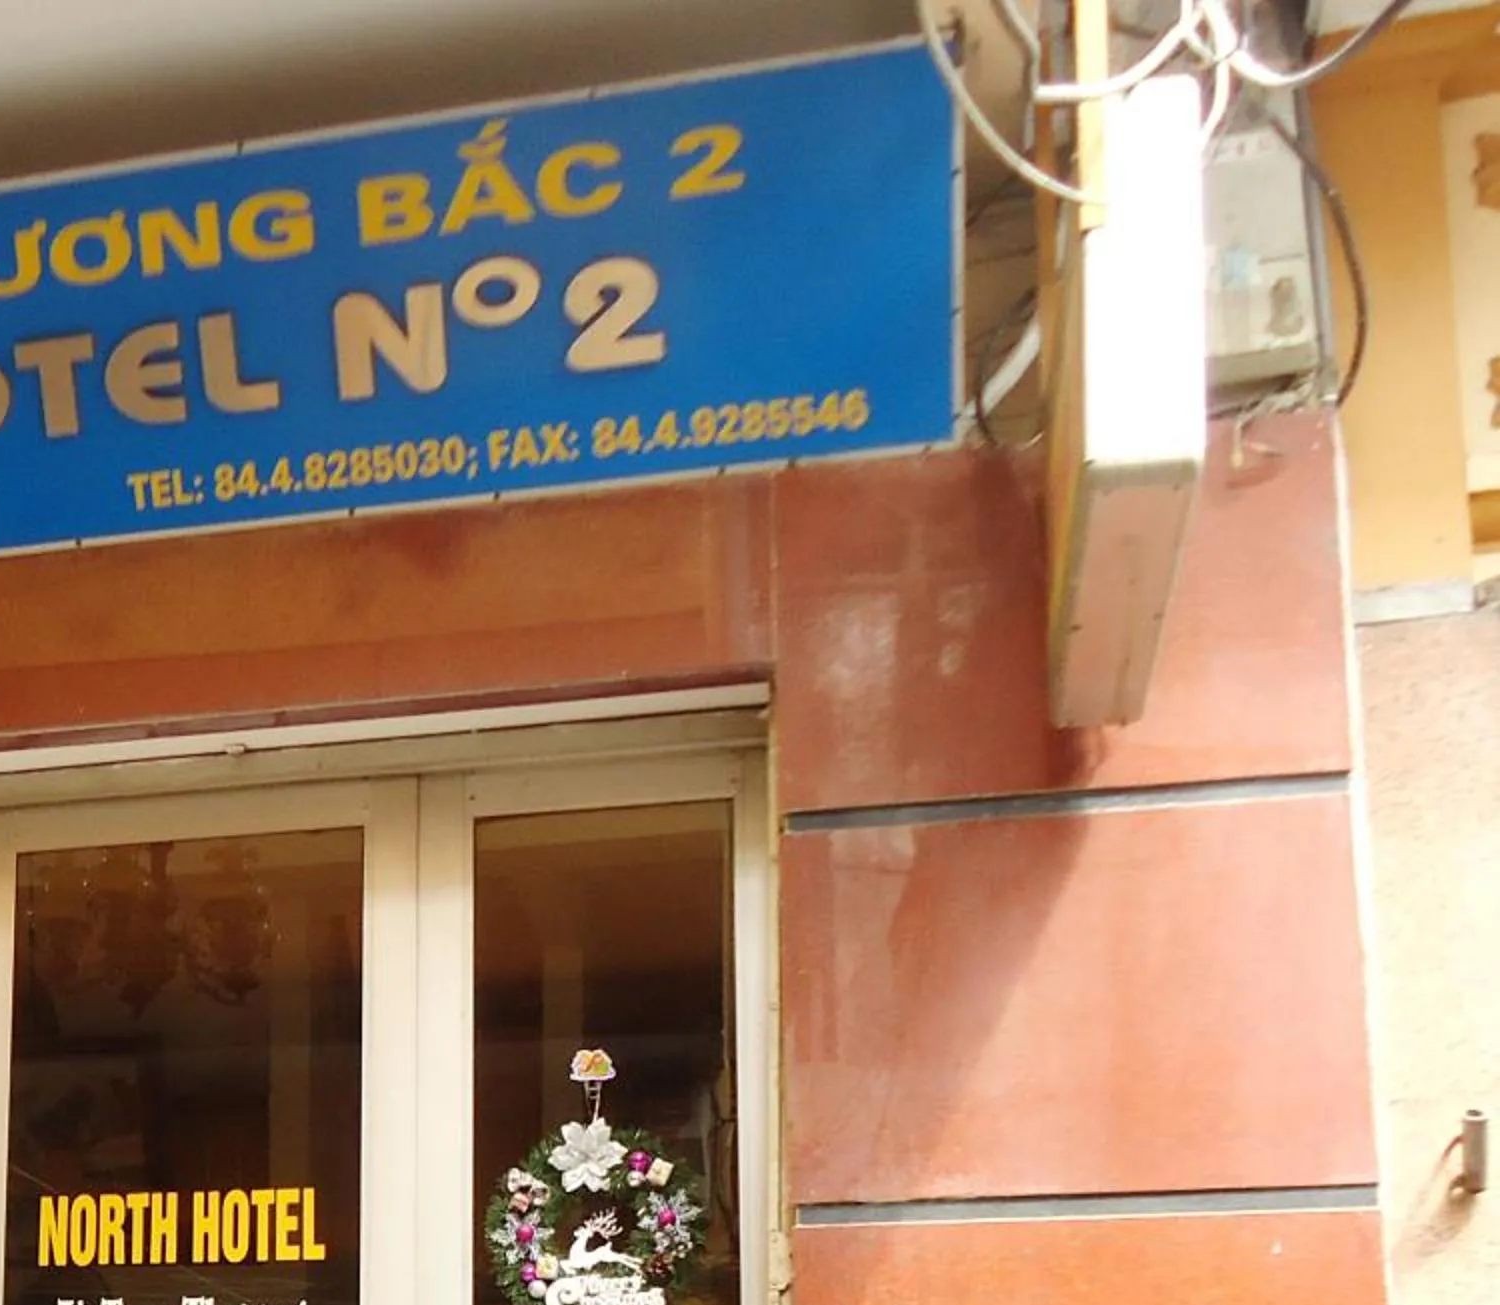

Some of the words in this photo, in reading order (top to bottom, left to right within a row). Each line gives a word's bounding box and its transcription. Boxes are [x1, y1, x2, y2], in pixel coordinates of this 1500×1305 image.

[357, 120, 623, 246] BẮC
[670, 124, 746, 198] 2
[564, 256, 666, 372] 2
[127, 469, 204, 511] TEL:
[487, 421, 580, 471] FAX:
[38, 1191, 179, 1267] NORTH
[191, 1187, 326, 1264] HOTEL
